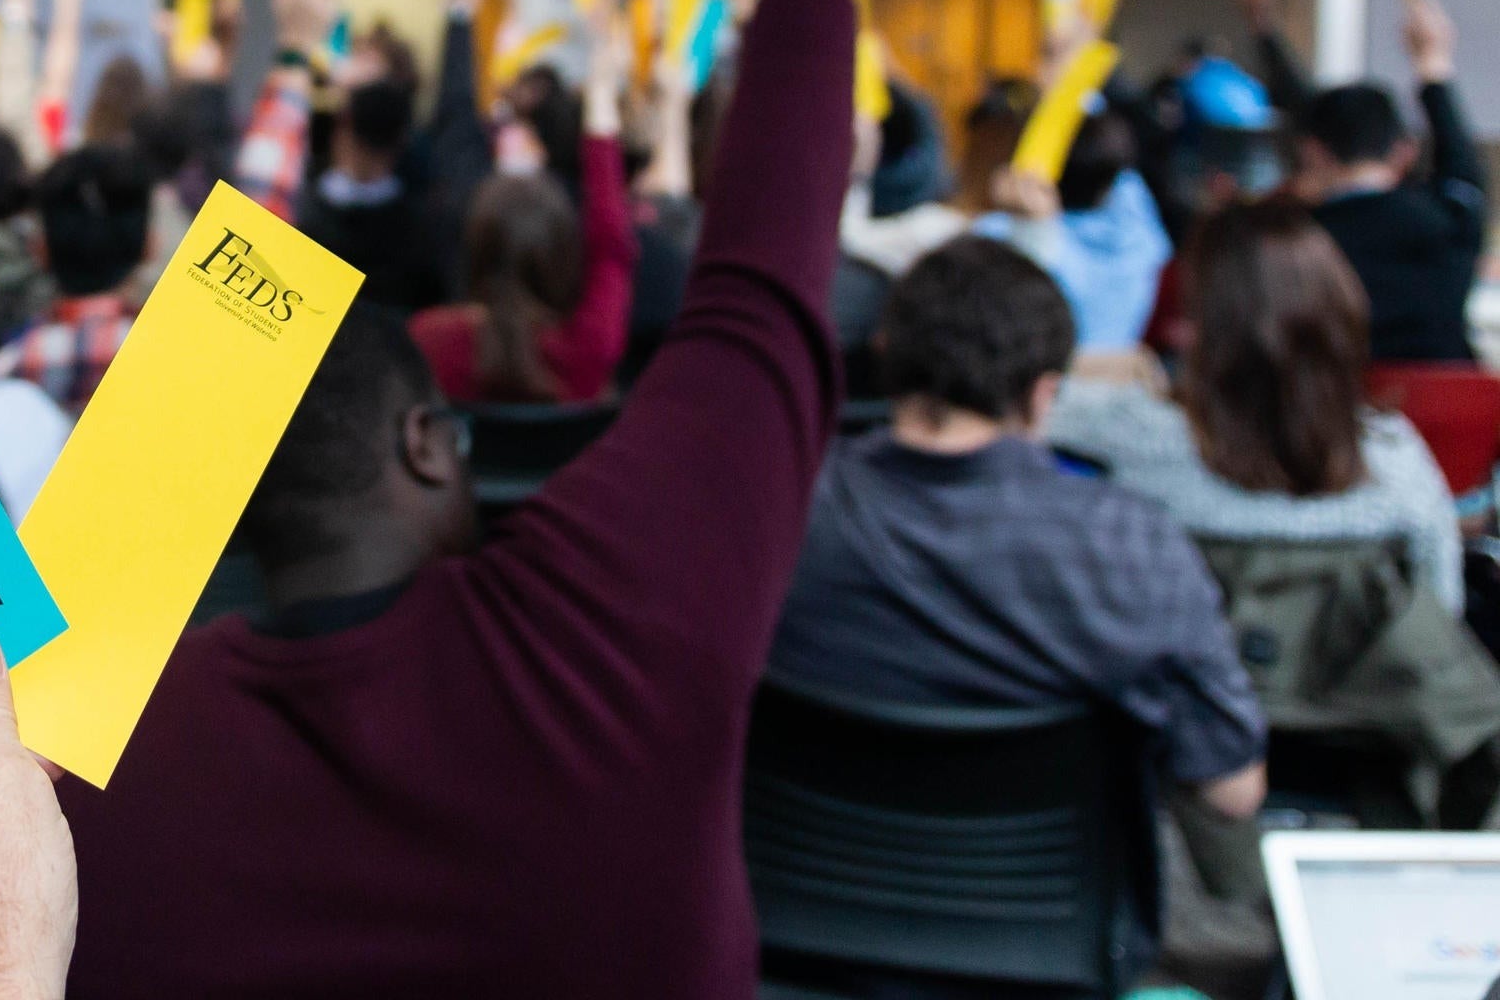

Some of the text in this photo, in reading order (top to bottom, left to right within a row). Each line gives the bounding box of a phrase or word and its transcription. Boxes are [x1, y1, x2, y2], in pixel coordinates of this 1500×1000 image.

[186, 267, 284, 336] FEDERATION OF STUDENTS
[192, 227, 303, 322] FEDS
[214, 298, 246, 321] University
[250, 322, 278, 343] Waterloo
